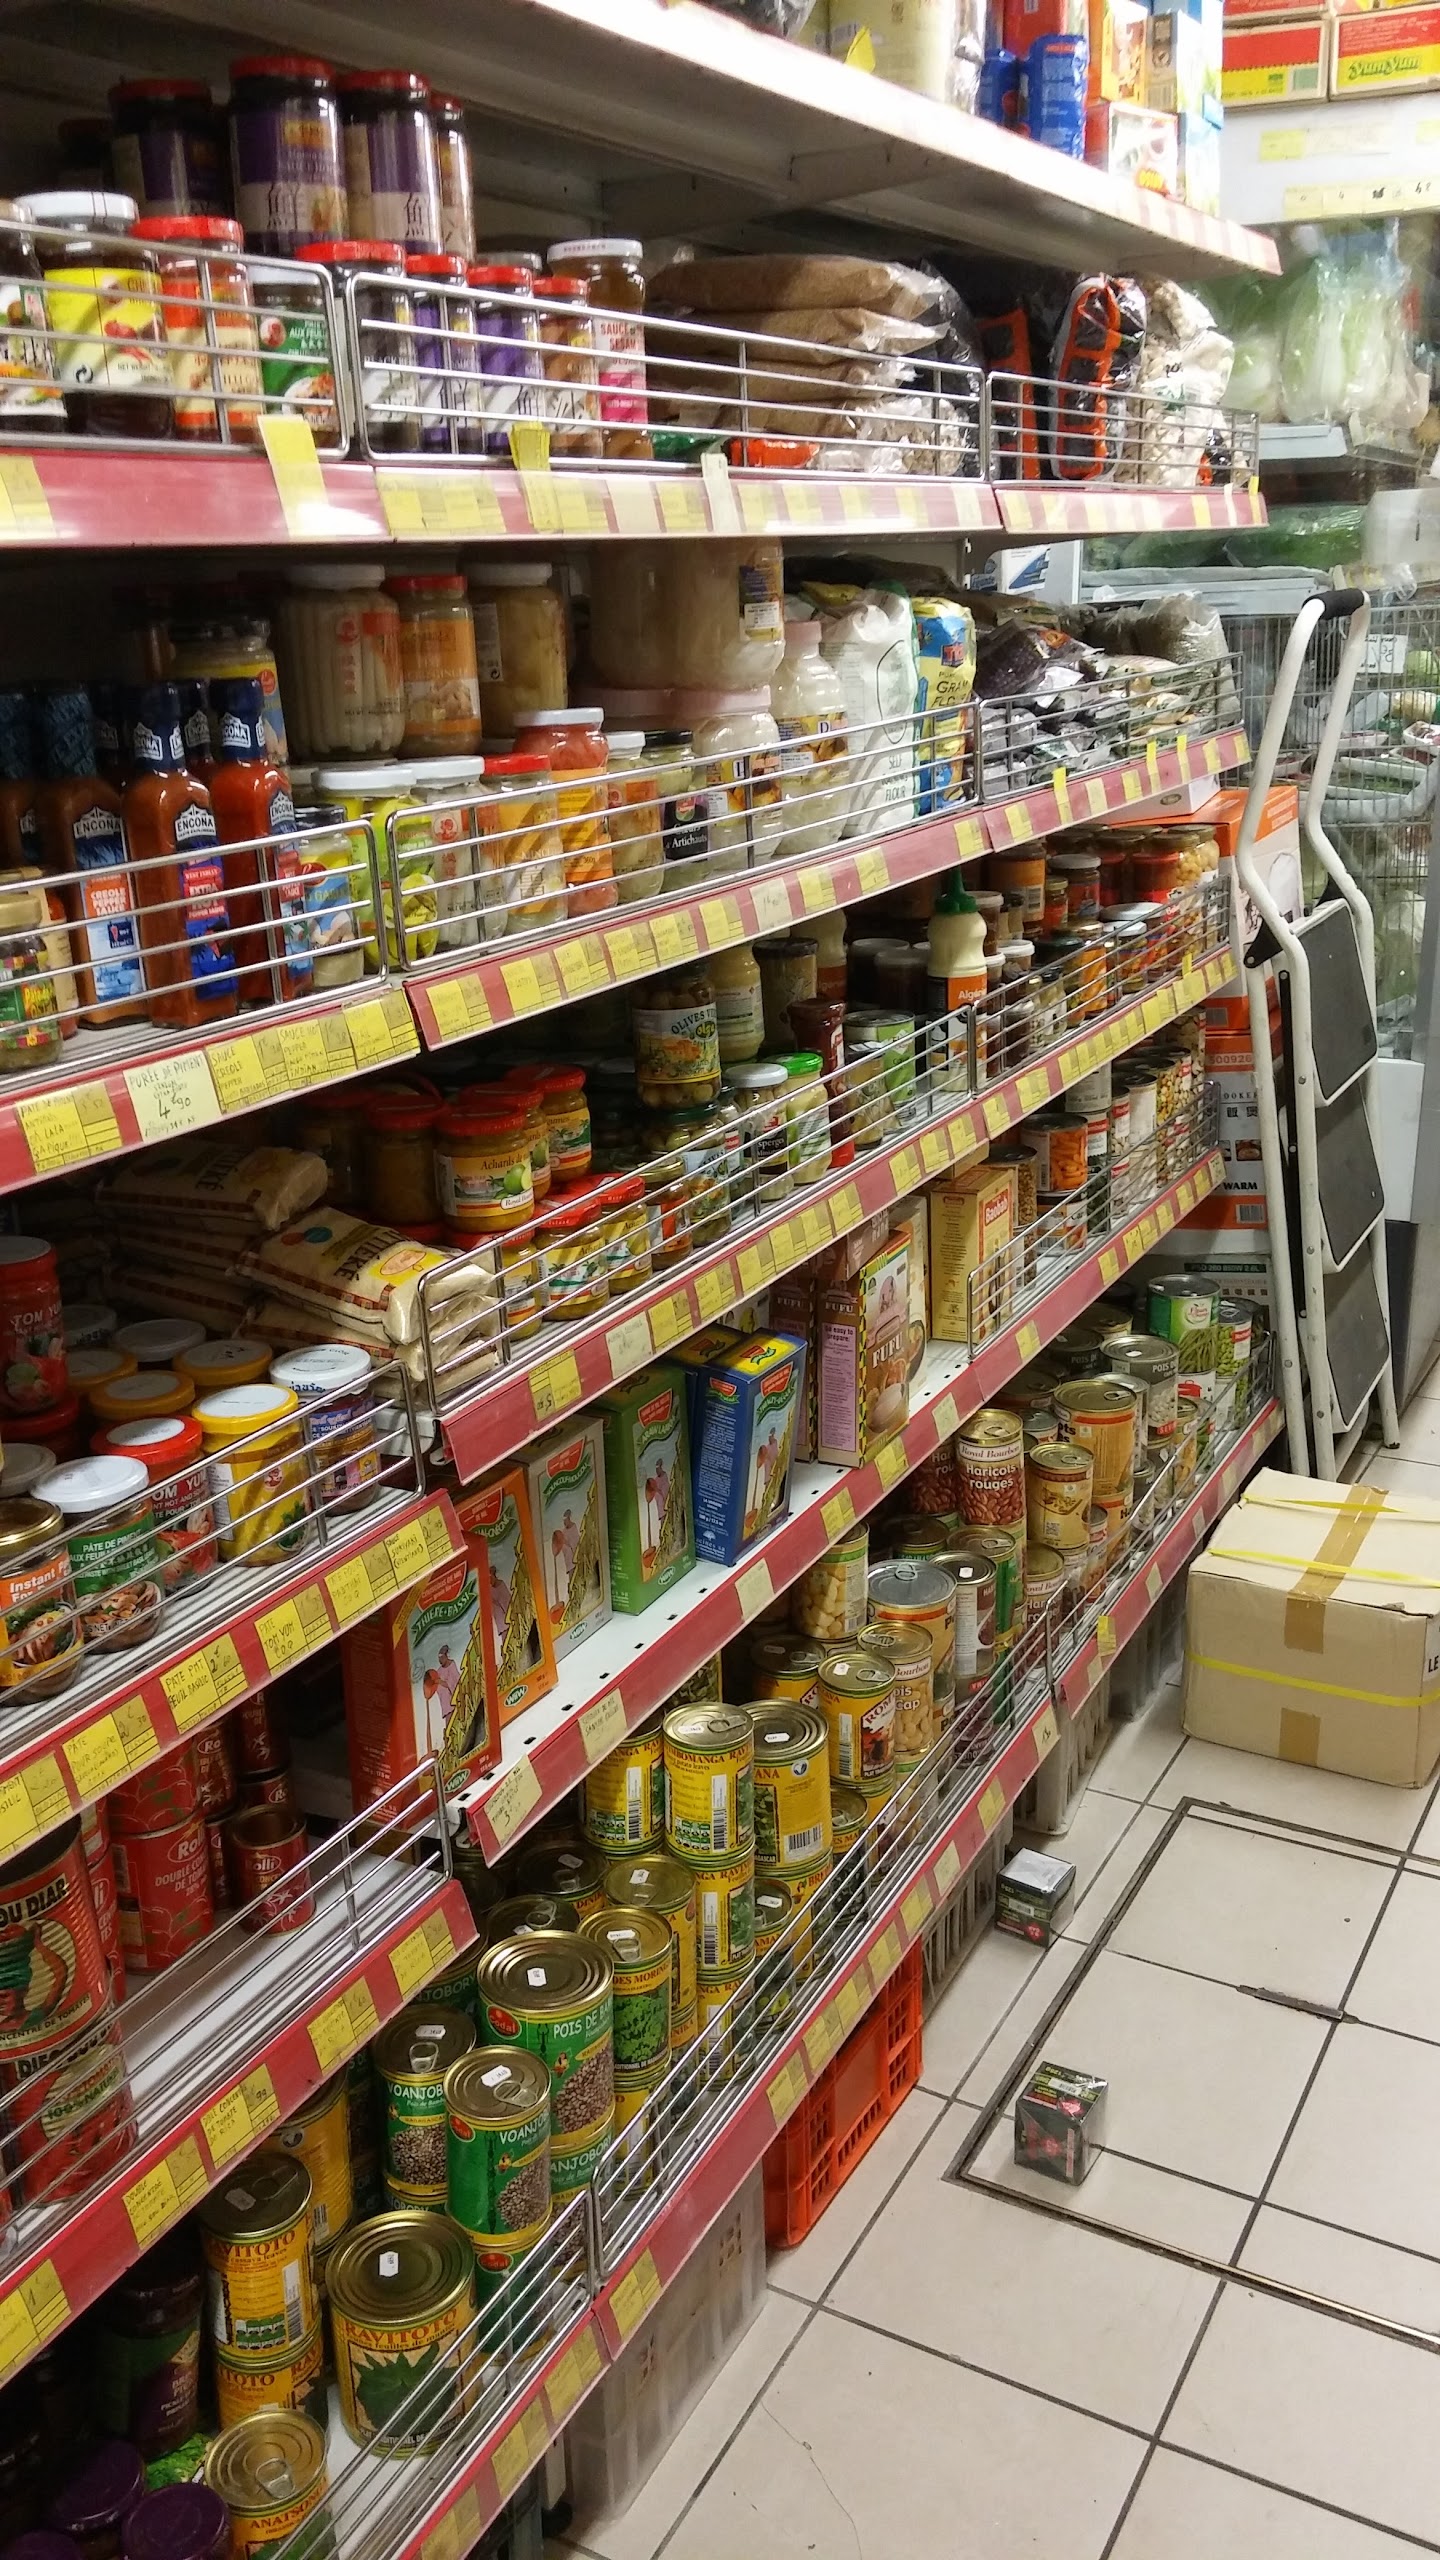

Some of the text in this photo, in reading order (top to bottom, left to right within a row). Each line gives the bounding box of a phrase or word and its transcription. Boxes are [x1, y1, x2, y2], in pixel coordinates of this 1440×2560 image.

[600, 322, 629, 336] SAUCE
[936, 680, 969, 694] GRAM
[885, 786, 906, 801] FLOUR
[271, 803, 294, 819] ENCONA
[76, 816, 121, 834] ENCONA
[177, 814, 214, 831] ENCONA
[90, 887, 127, 899] CREOLE
[189, 883, 219, 897] EXTRA
[93, 896, 127, 907] PEPPER
[95, 905, 126, 917] SAUCE
[670, 1011, 705, 1035] OLIVES
[279, 1026, 305, 1042] SAUCE
[211, 1046, 235, 1067] SAUCE
[481, 1156, 515, 1170] Achards
[1223, 1181, 1258, 1191] WARM
[985, 1196, 1009, 1226] Baobab
[825, 1301, 855, 1313] FUFU
[14, 1311, 44, 1326] TOM
[833, 1326, 855, 1338] easy to
[872, 1334, 903, 1369] FUFU
[1152, 1363, 1170, 1374] POIS
[985, 1444, 1020, 1459] Bourbon
[965, 1462, 1016, 1477] Haricots
[969, 1477, 1014, 1491] rouges
[164, 1499, 179, 1508] HOT
[166, 1507, 185, 1517] POUR
[83, 1540, 104, 1552] PÂTE
[105, 1539, 116, 1550] DE
[69, 1553, 84, 1563] AUX
[10, 1569, 56, 1593] Instant
[264, 1634, 279, 1649] TOM
[1428, 1655, 1440, 1673] LE
[165, 1672, 186, 1694] PATE
[754, 1769, 781, 1780] ANA
[155, 1867, 189, 1887] DOUBLE
[174, 1878, 185, 1893] DE
[26, 1877, 70, 1920] DIAR
[44, 2019, 57, 2029] DE
[57, 1994, 91, 2022] TOMATES
[553, 2015, 599, 2041] POIS DE
[387, 2080, 443, 2100] VOANJOB
[264, 2248, 288, 2259] leaves
[345, 2307, 459, 2346] RAVITOTO
